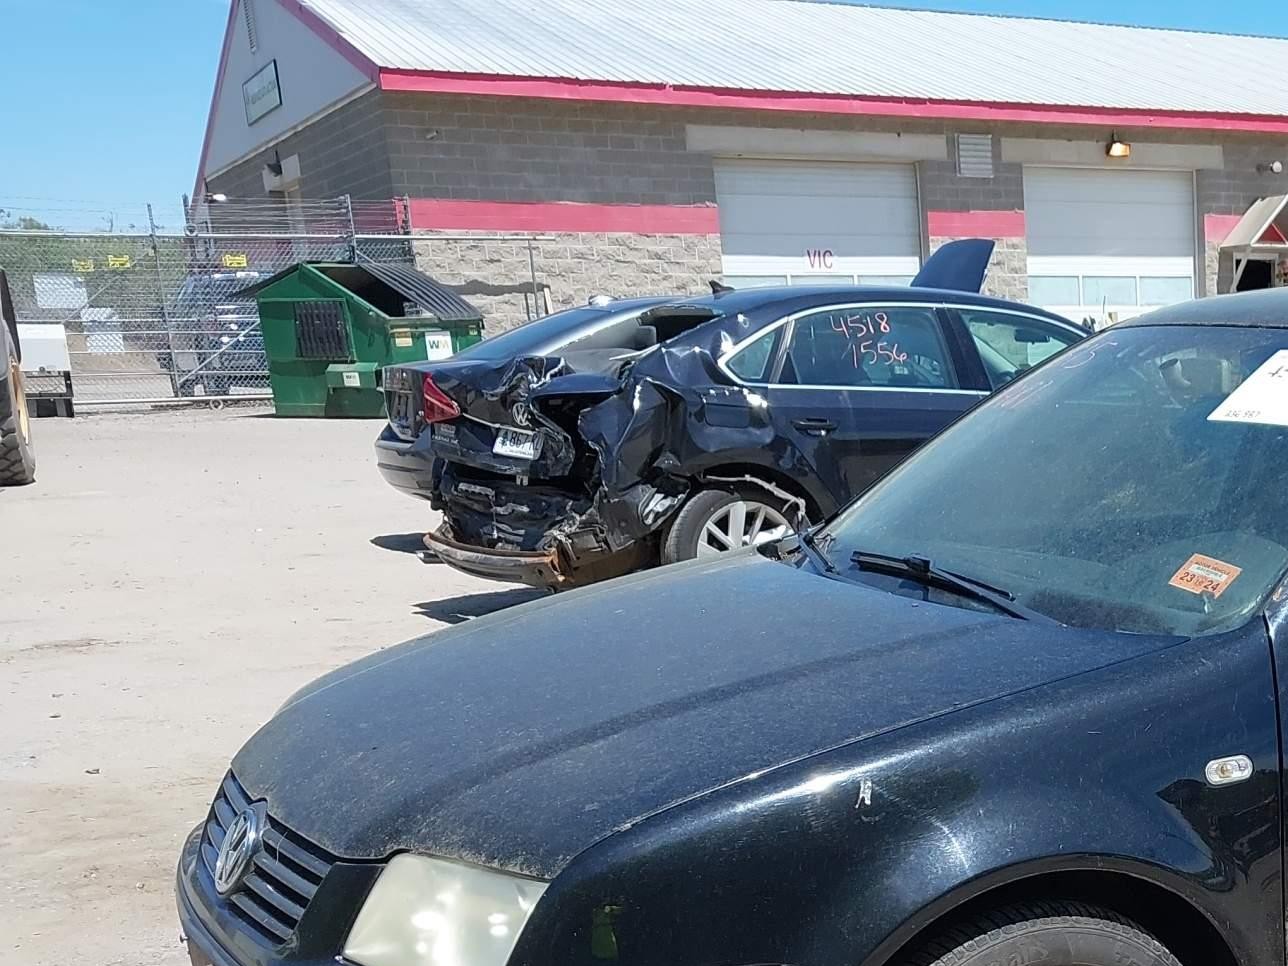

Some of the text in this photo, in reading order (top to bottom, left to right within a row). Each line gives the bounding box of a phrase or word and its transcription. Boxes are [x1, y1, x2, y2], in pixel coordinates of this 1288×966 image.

[807, 249, 833, 269] VIC
[829, 312, 890, 339] 4518
[852, 340, 907, 368] 1556
[1179, 572, 1196, 583] 23
[1203, 580, 1220, 591] 24
